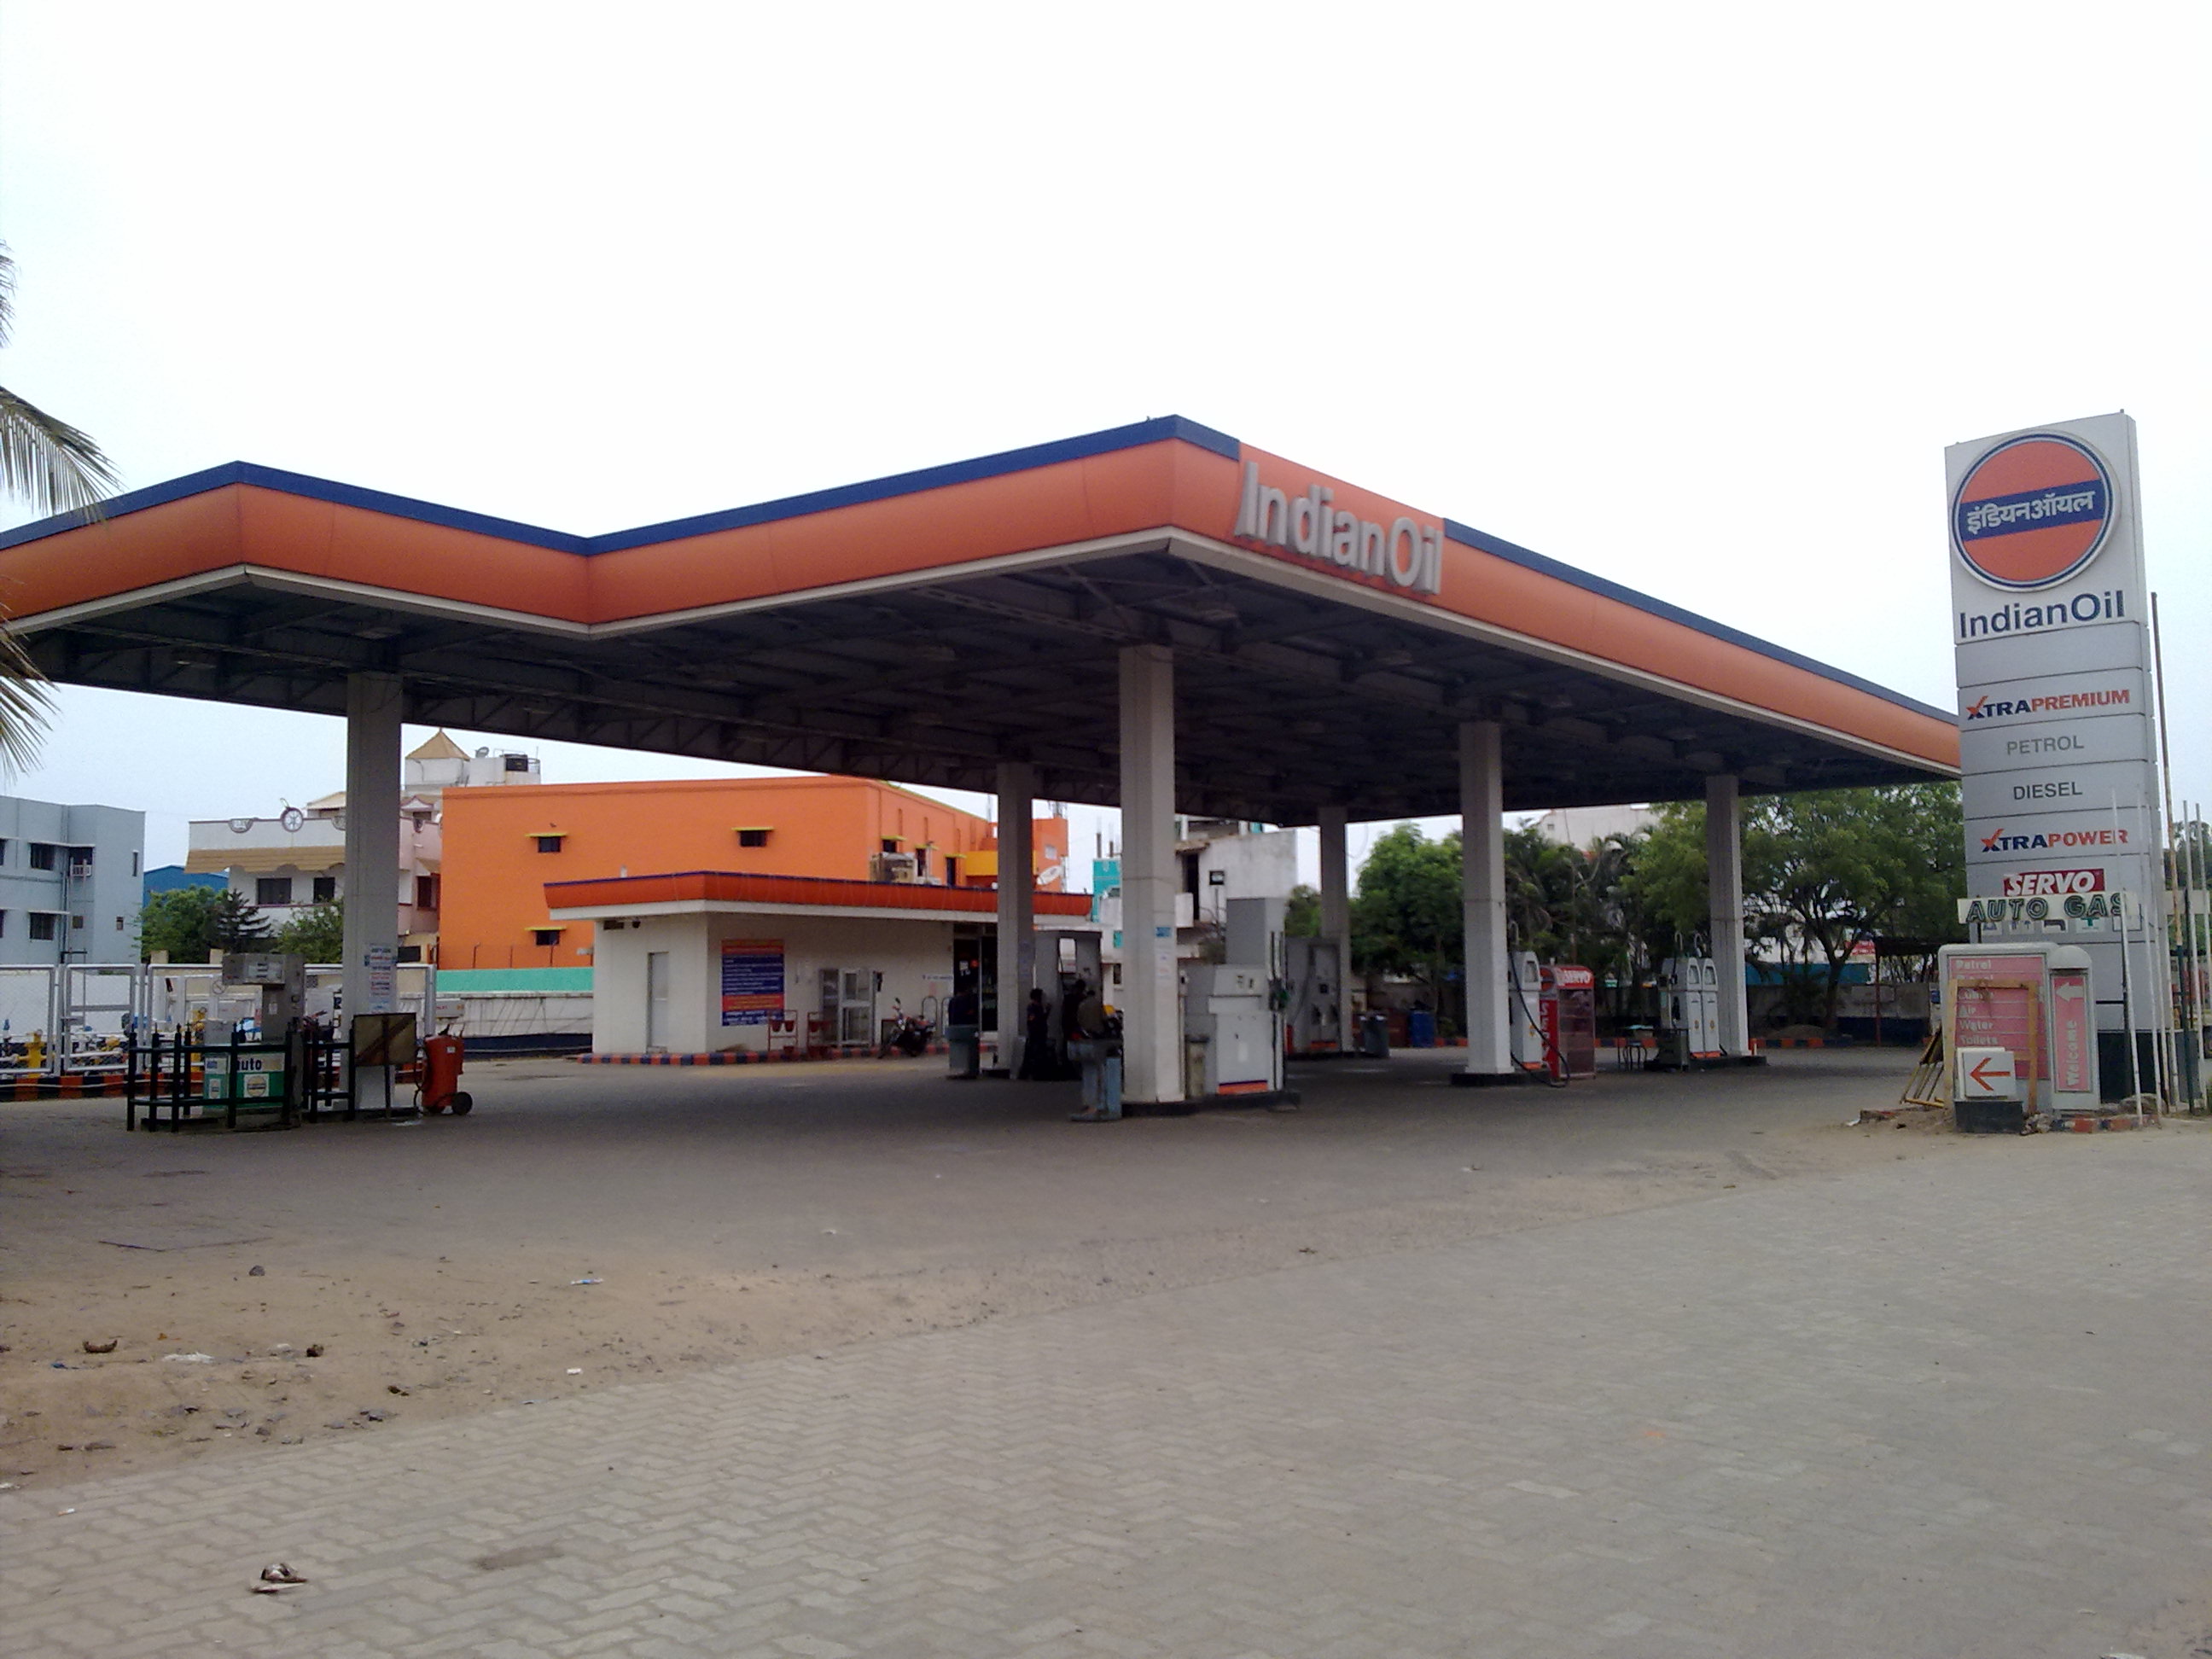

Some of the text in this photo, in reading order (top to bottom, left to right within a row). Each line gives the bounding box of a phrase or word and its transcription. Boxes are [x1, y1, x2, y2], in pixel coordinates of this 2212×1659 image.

[1967, 490, 2096, 534] इंडियनऑयल
[1235, 461, 1443, 594] IndianOil
[1959, 590, 2125, 638] IndianOil
[2006, 735, 2085, 755] PETROL
[2013, 781, 2083, 800] DIESEL
[2005, 870, 2096, 895] SERVO
[1966, 893, 2122, 923] AUTO GAS
[237, 1058, 262, 1070] uto
[2067, 1021, 2080, 1086] Welcome
